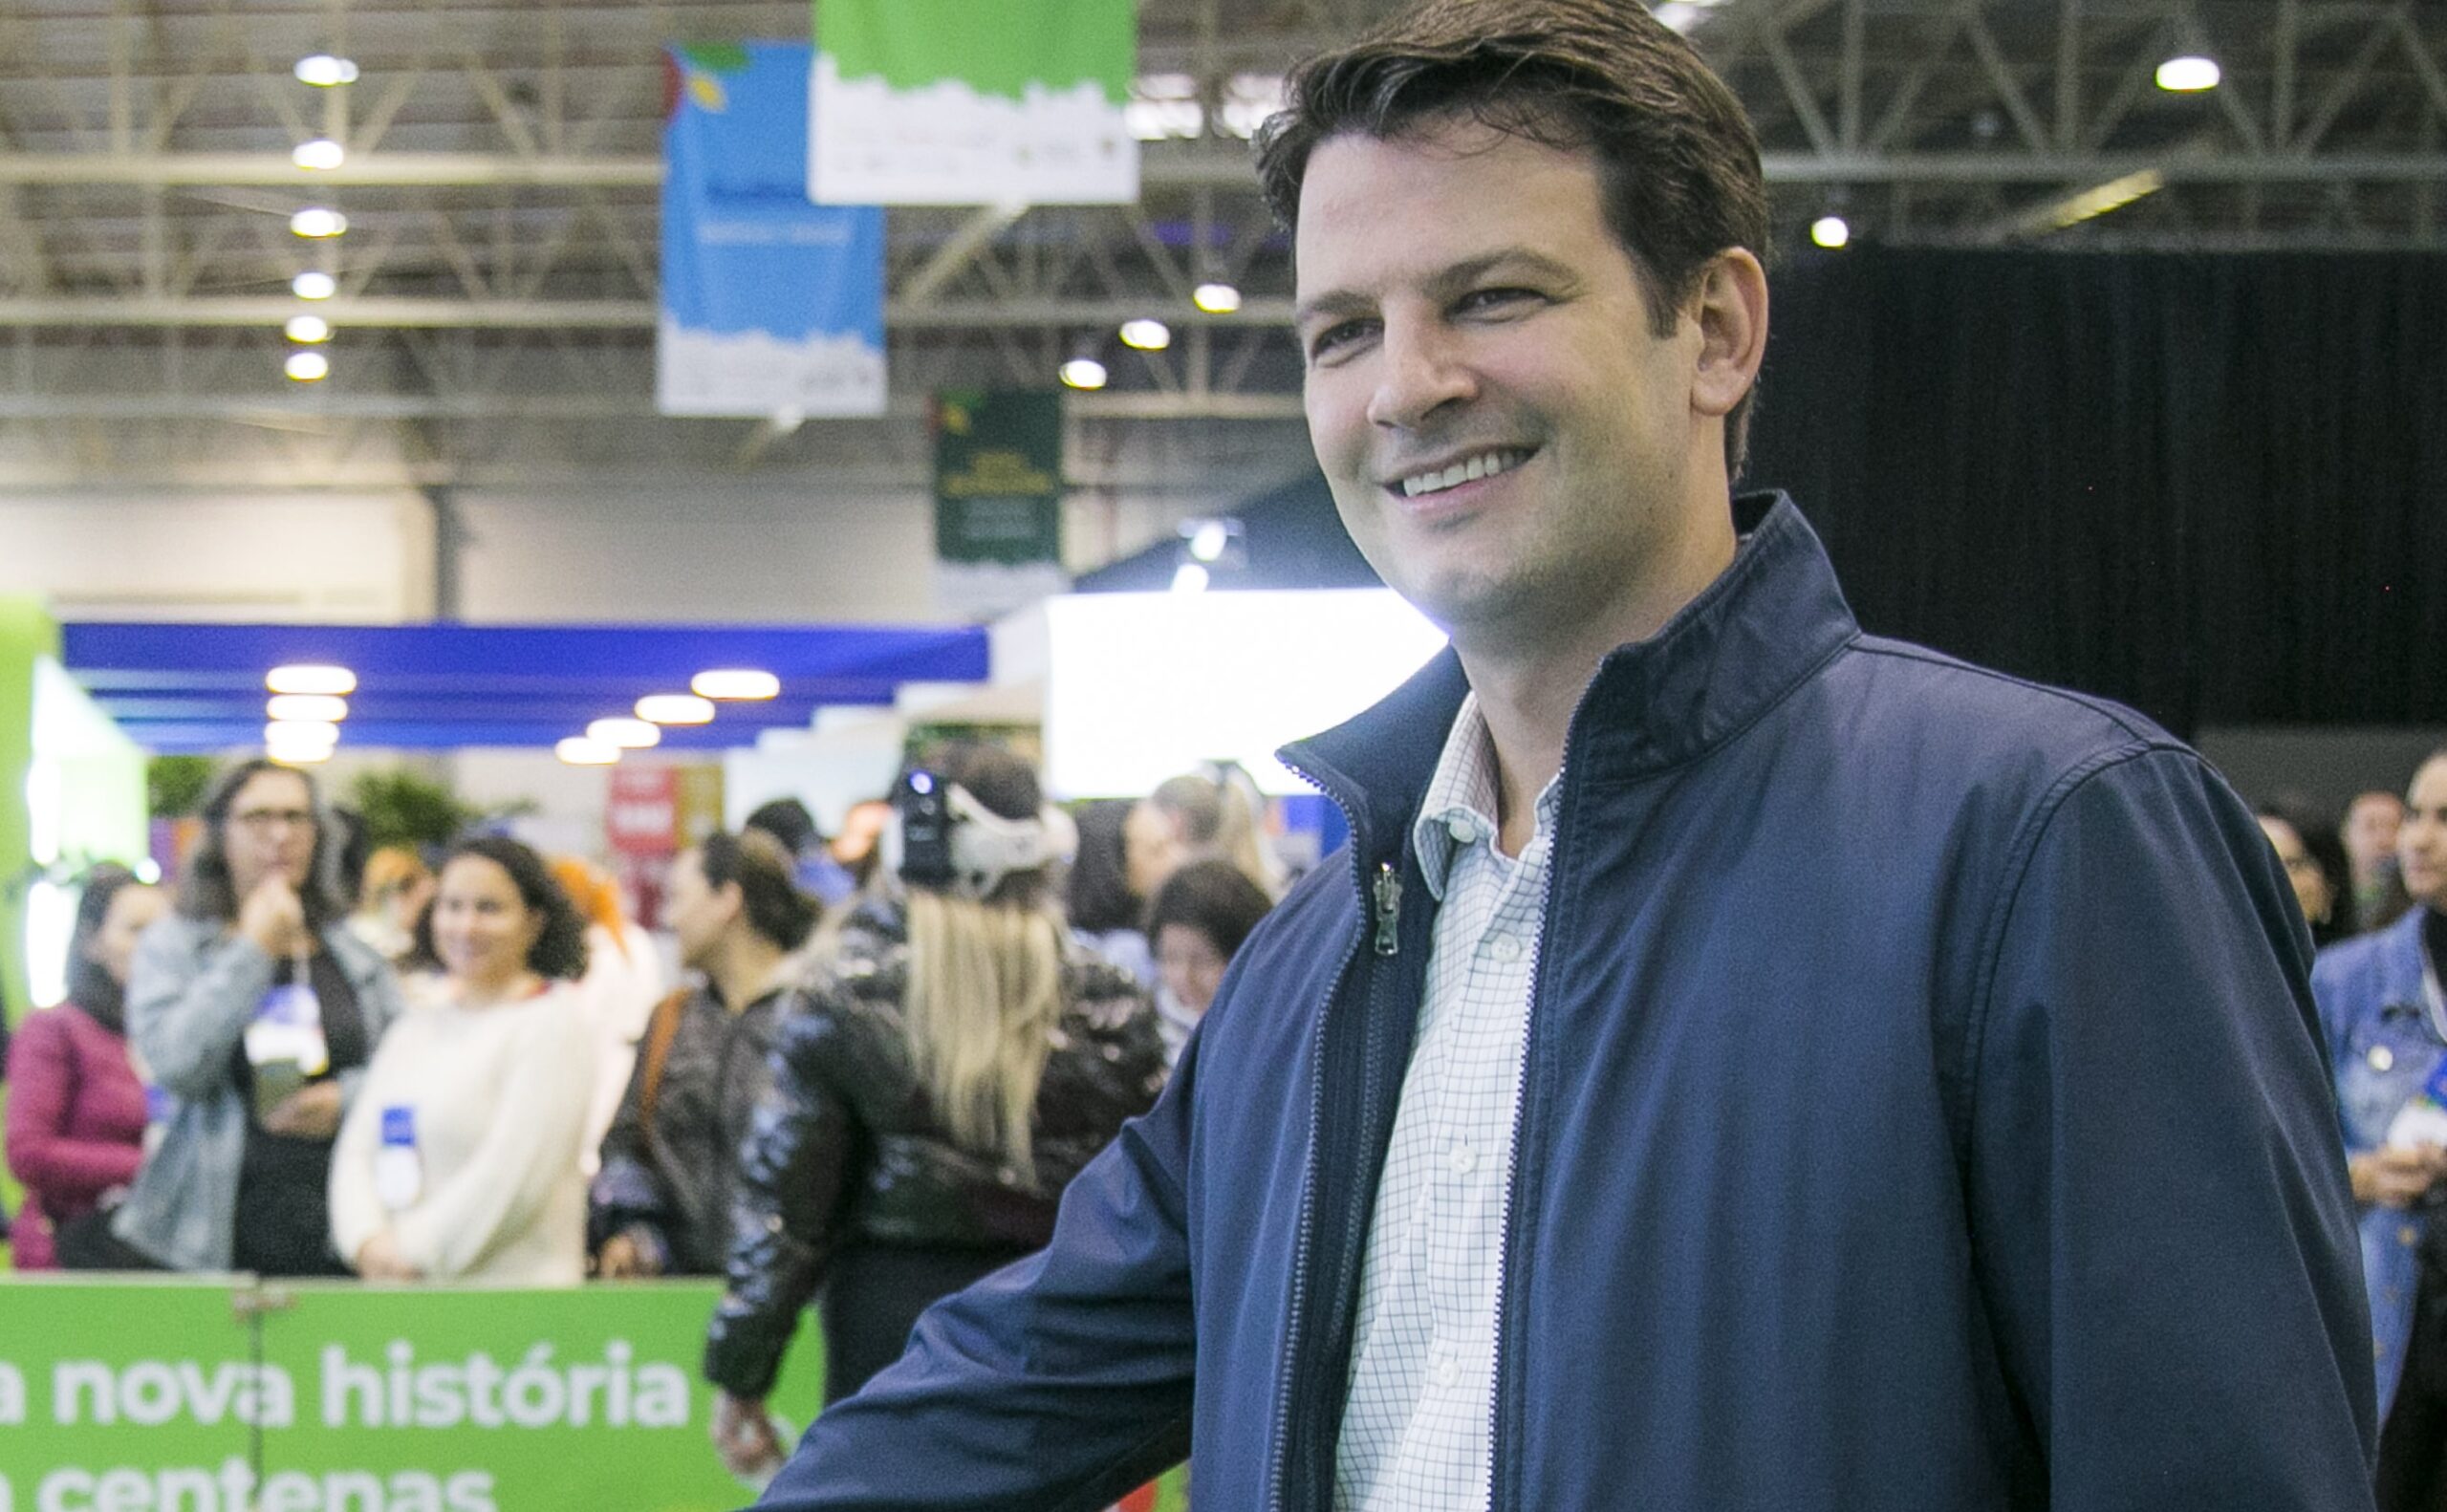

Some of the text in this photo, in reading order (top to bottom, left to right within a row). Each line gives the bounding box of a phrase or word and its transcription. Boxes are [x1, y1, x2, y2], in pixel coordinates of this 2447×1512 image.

[53, 1360, 294, 1427] nova
[321, 1338, 690, 1428] história
[36, 1455, 498, 1512] centenas
